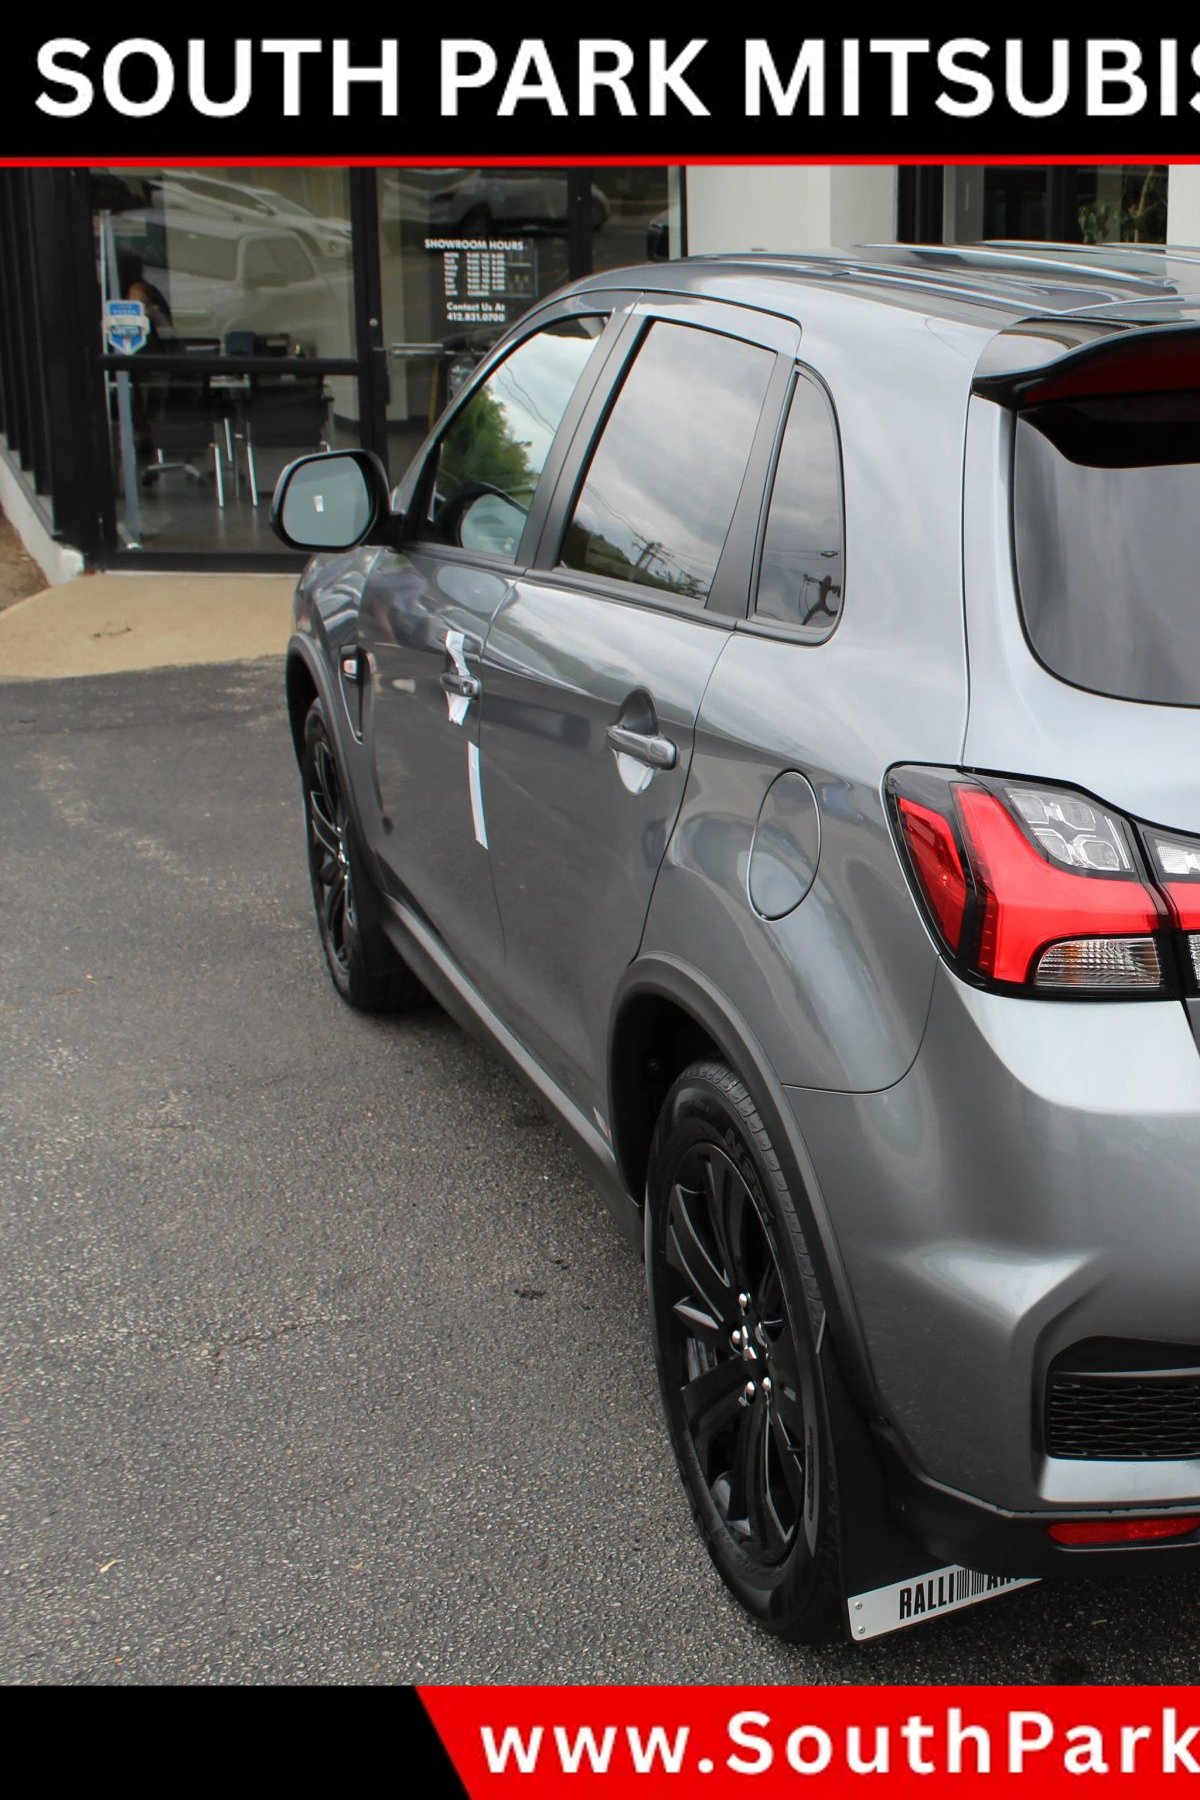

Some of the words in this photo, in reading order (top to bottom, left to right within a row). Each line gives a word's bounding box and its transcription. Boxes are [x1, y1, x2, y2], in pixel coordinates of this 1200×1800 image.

[424, 239, 487, 250] SHOWROOM
[489, 241, 523, 251] HOURS
[446, 302, 480, 312] Contact
